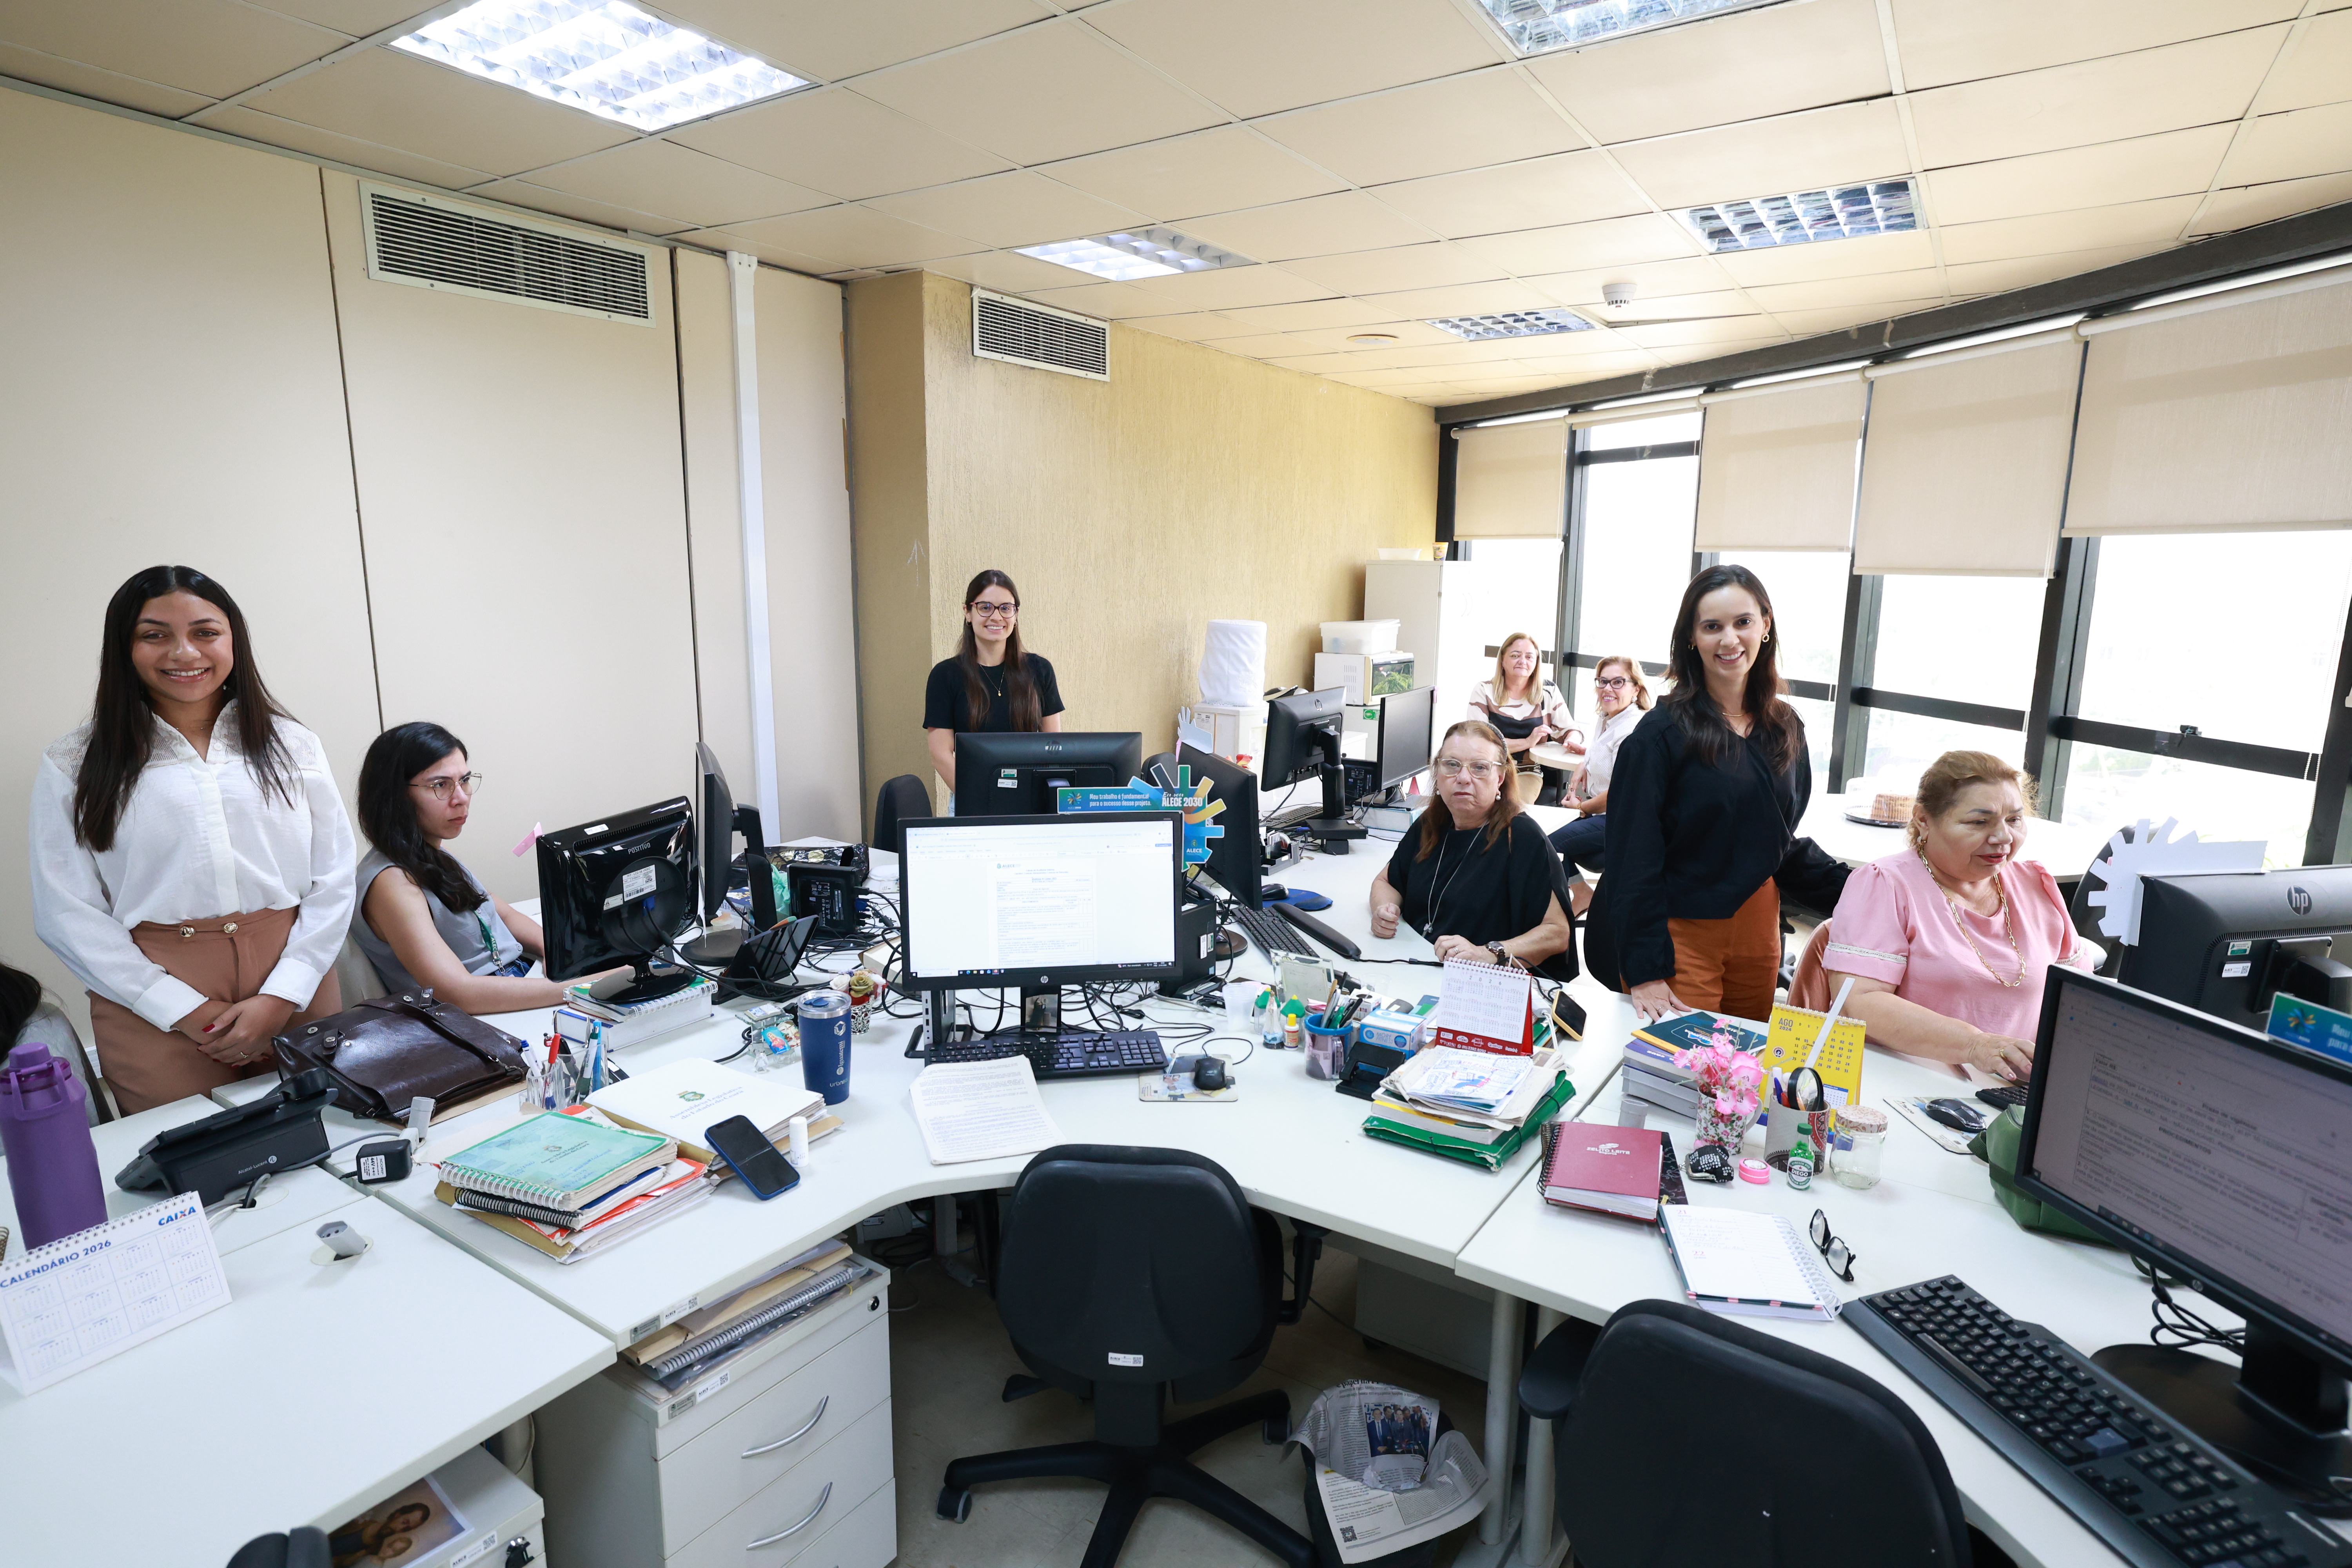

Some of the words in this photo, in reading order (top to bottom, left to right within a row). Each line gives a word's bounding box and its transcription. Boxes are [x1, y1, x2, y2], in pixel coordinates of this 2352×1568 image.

[1162, 797, 1182, 807] ALECE
[1183, 797, 1203, 807] 2030
[628, 842, 651, 854] POSITIVO
[2290, 885, 2308, 915] hp
[1470, 976, 1501, 985] 2026
[1779, 1018, 1793, 1027] AGO
[670, 1101, 707, 1120] Assembleia
[707, 1086, 743, 1102] Legislativa
[691, 1103, 714, 1115] Estado
[724, 1090, 744, 1100] Ceará
[238, 1160, 268, 1174] Alcatel-Lucent
[1791, 1168, 1808, 1177] DIEGO
[158, 1206, 196, 1226] CAIXA
[0, 1252, 79, 1288] CALENDÁRIO
[83, 1240, 111, 1256] 2026
